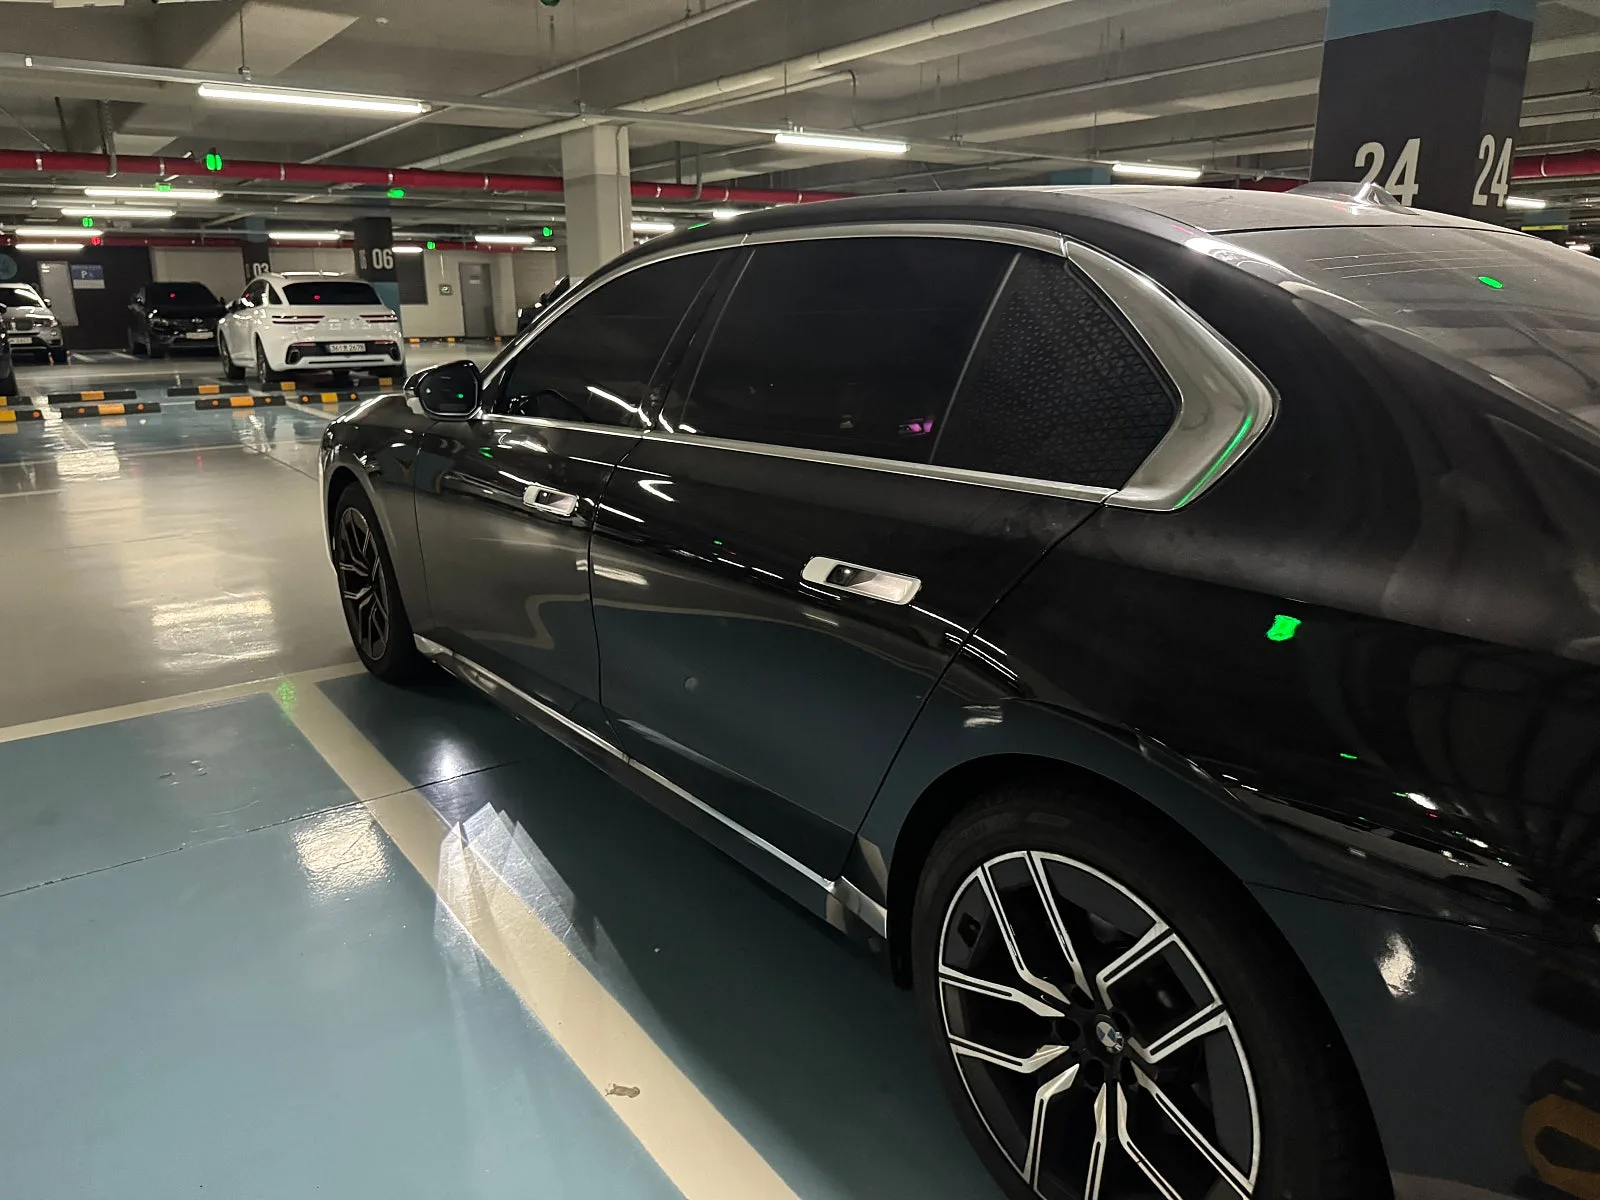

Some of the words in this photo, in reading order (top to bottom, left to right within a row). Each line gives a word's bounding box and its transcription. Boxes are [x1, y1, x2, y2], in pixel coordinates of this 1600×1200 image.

[1354, 137, 1421, 206] 24
[1472, 134, 1513, 207] 24
[372, 248, 394, 270] 06
